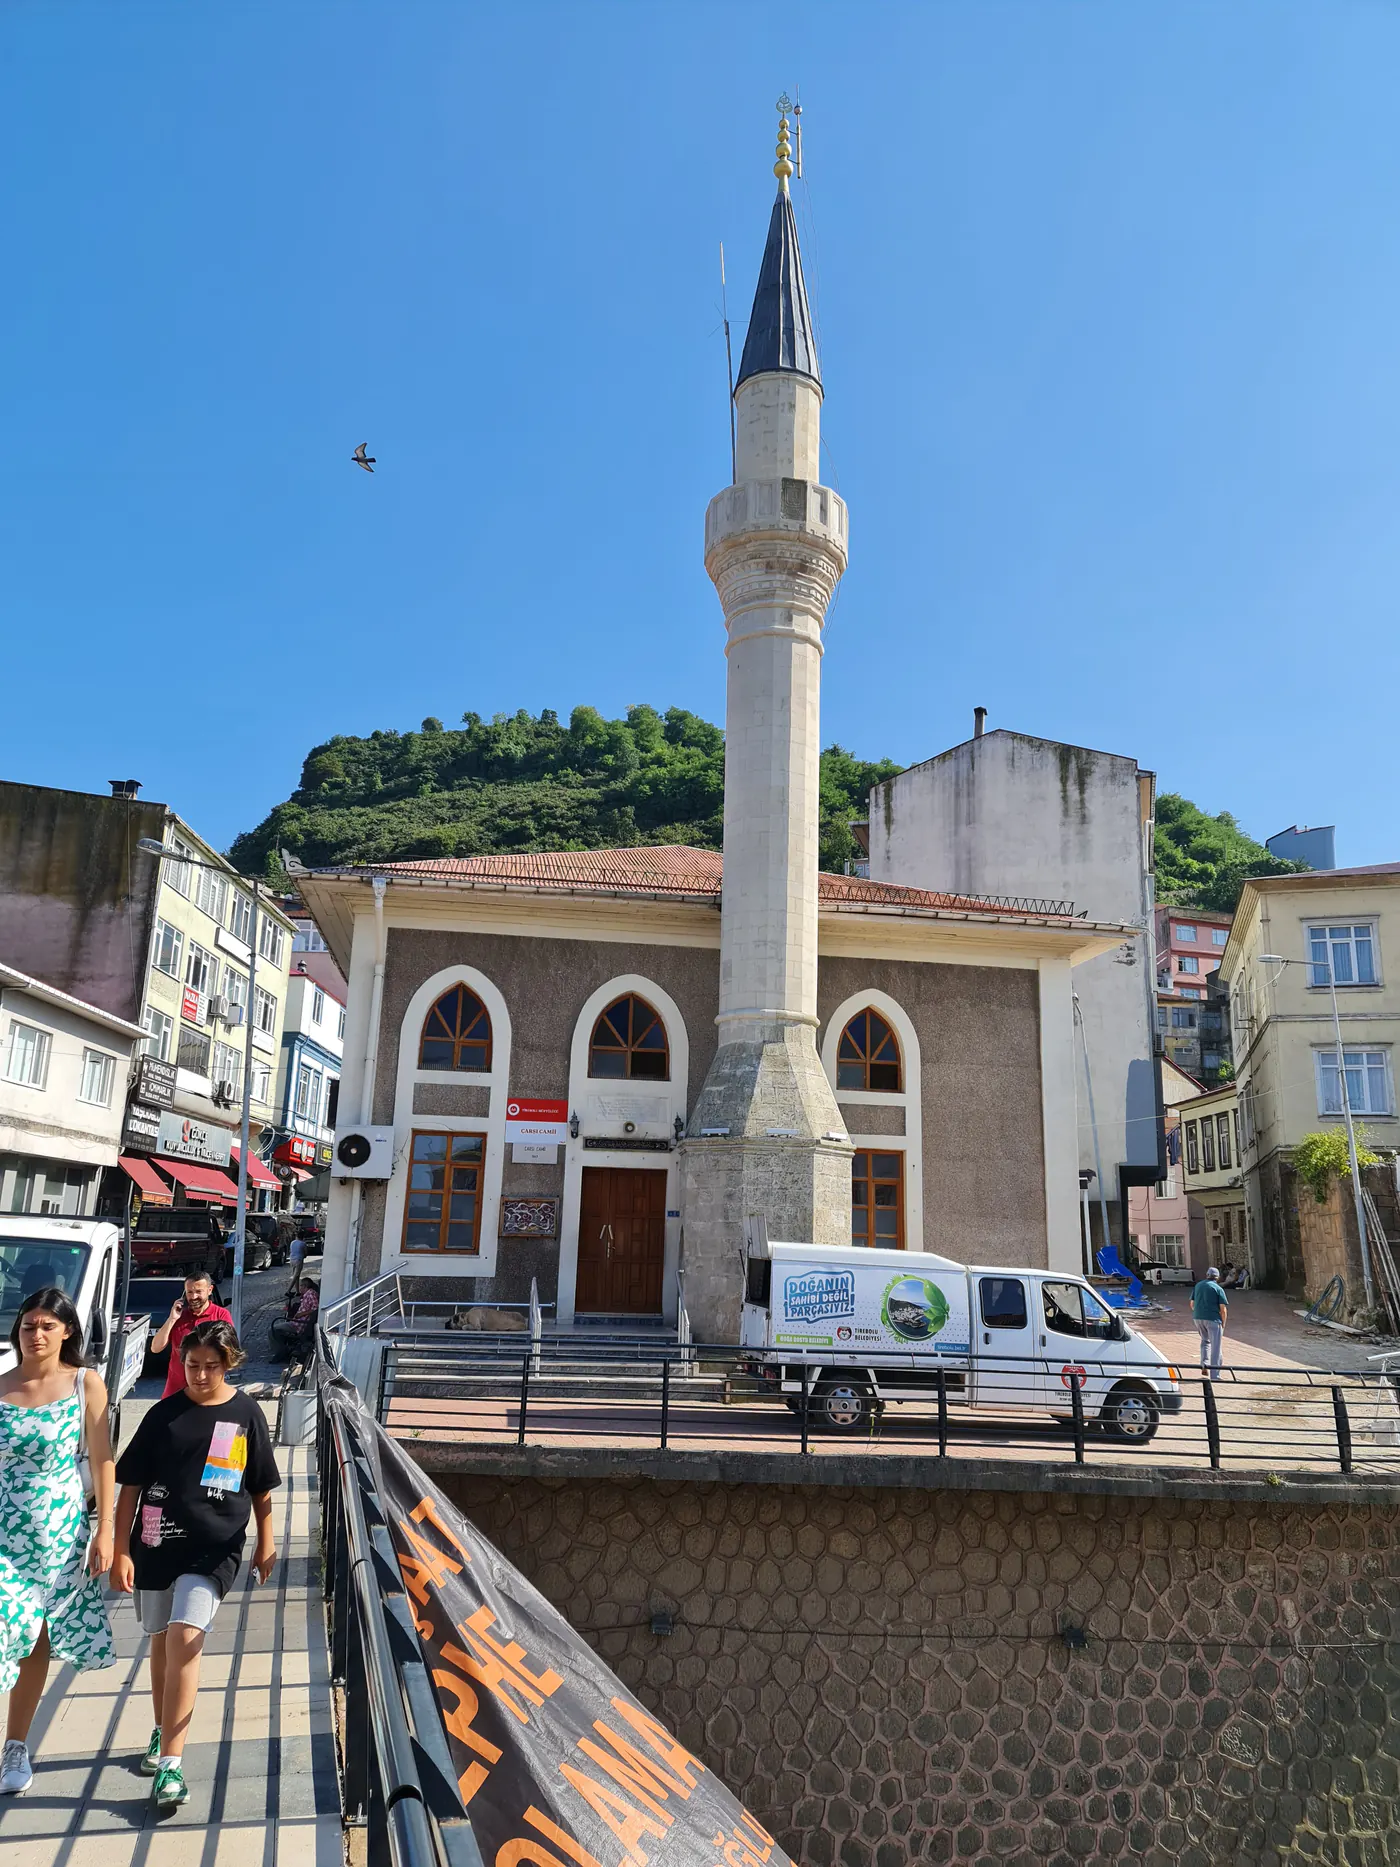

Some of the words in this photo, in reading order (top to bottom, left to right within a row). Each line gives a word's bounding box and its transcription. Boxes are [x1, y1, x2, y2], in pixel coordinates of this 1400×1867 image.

[789, 1276, 849, 1293] DOĞANIN
[790, 1293, 820, 1306] SAHİBİ
[822, 1290, 848, 1303] DEĞİL
[432, 1604, 565, 1806] PHE
[711, 1808, 775, 1867] ĞLU
